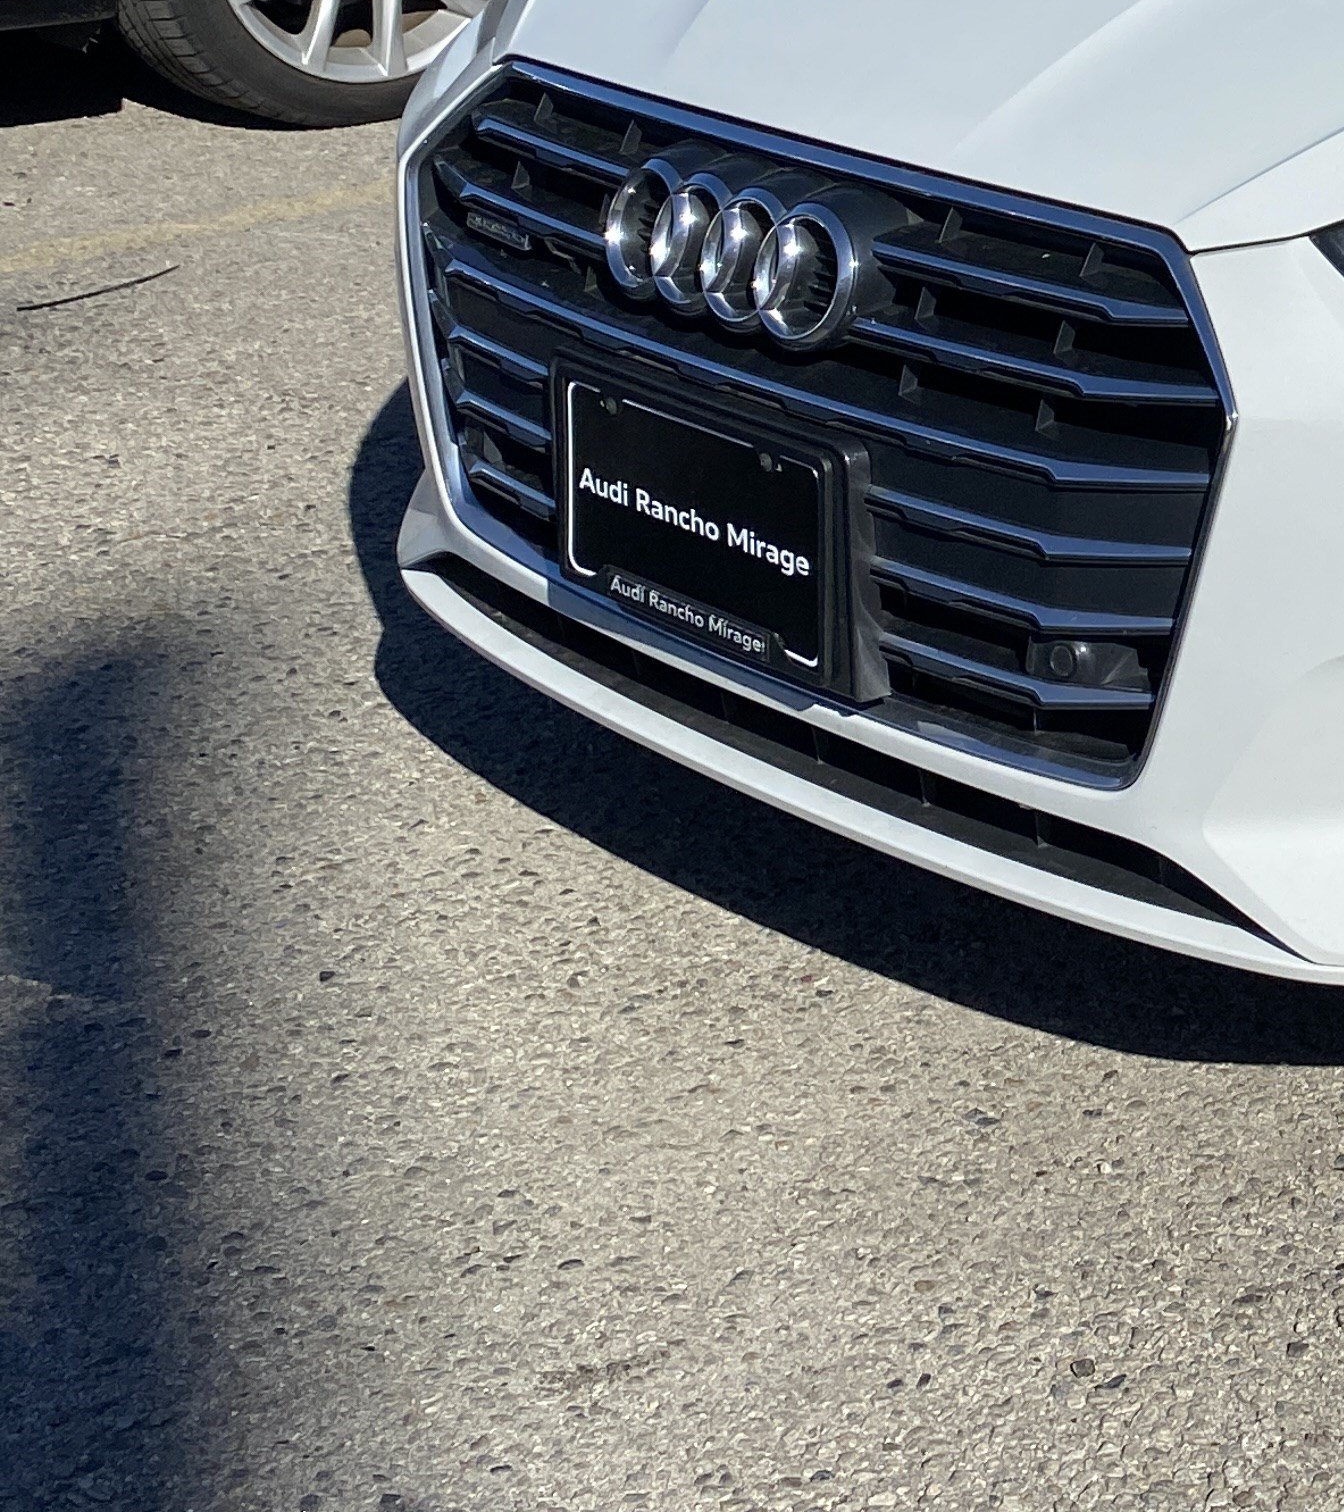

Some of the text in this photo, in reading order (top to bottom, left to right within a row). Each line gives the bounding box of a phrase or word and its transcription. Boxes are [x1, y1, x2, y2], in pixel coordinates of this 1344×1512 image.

[578, 467, 811, 577] Audi Rancho Mirage
[609, 574, 765, 653] Audi Rancho Mirage
